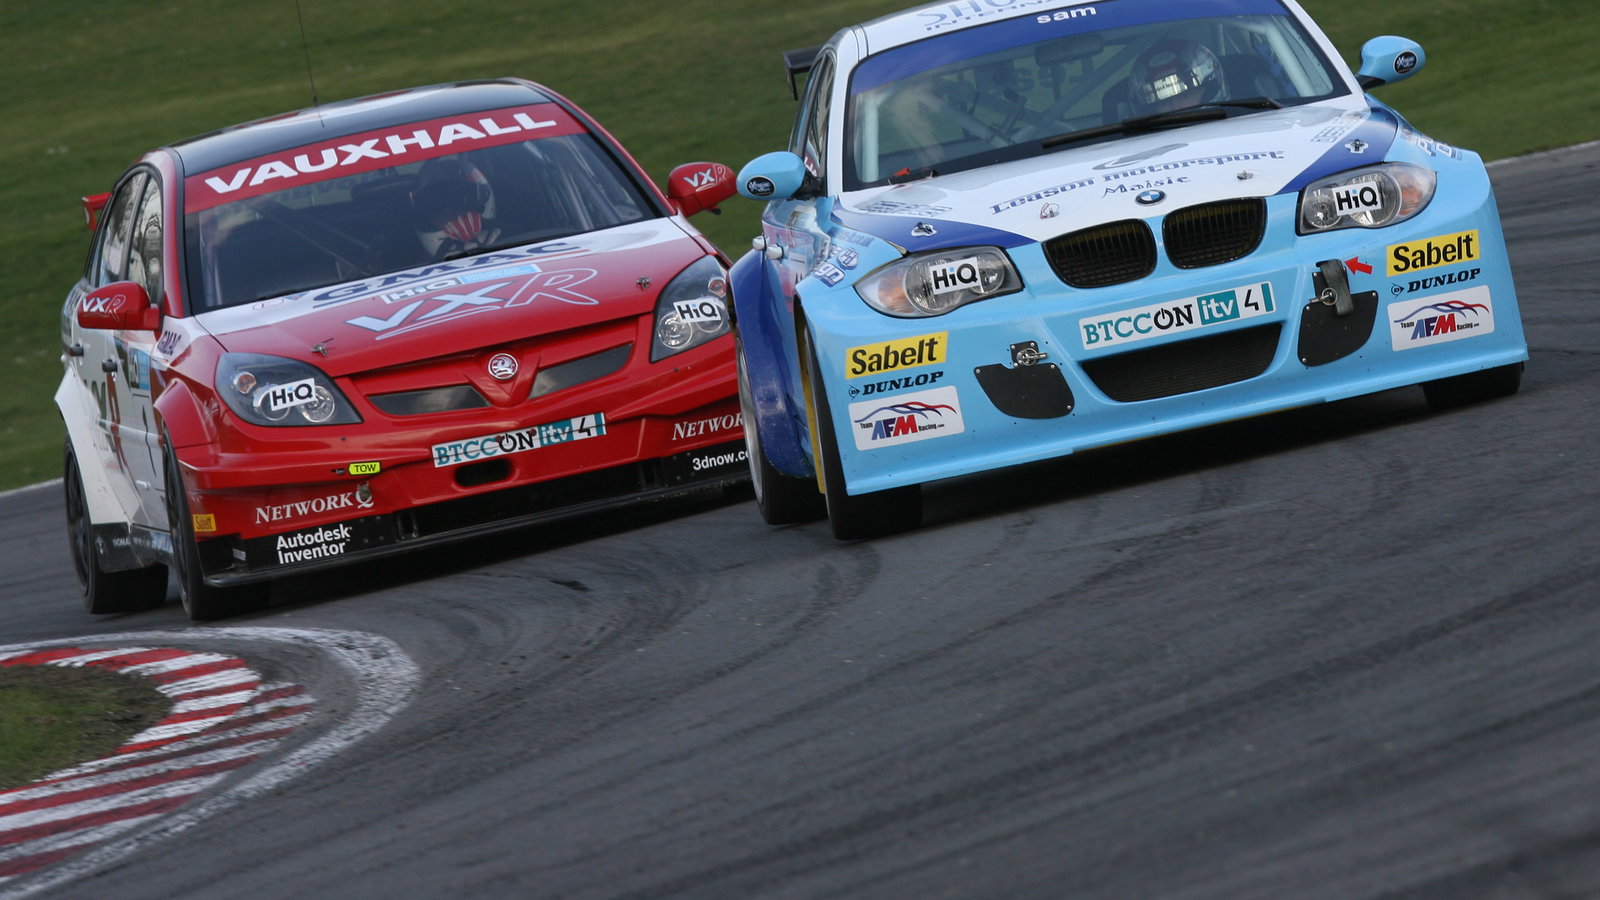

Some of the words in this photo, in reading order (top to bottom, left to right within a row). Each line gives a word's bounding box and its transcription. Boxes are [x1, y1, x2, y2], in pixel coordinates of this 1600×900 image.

[1037, 6, 1097, 24] sam
[205, 112, 557, 194] VAUXHALL
[684, 163, 731, 189] VXR
[989, 177, 1095, 215] Leason
[1102, 150, 1285, 182] motorsport
[1336, 186, 1378, 211] HiQ
[1393, 234, 1474, 273] Sabelt
[313, 242, 581, 303] GMAC
[932, 263, 978, 290] HiQ
[1407, 268, 1481, 293] DUNLOP
[346, 267, 599, 332] VXR
[388, 279, 460, 304] HiQ
[1201, 298, 1234, 321] itv
[1244, 289, 1260, 312] 4
[82, 294, 126, 320] VXR
[677, 302, 718, 320] HiQ
[1401, 321, 1415, 329] Team
[1410, 313, 1457, 341] AFM
[851, 338, 938, 376] Sabelt
[272, 383, 314, 407] HiQ
[862, 371, 944, 396] DUNLOP
[541, 425, 570, 445] itv
[578, 417, 592, 437] 4
[860, 421, 873, 429] Team
[871, 414, 919, 441] AFM
[354, 463, 376, 473] TOW
[255, 492, 353, 524] NETWORK
[276, 523, 351, 550] Autodesk
[278, 542, 346, 564] Inventor
